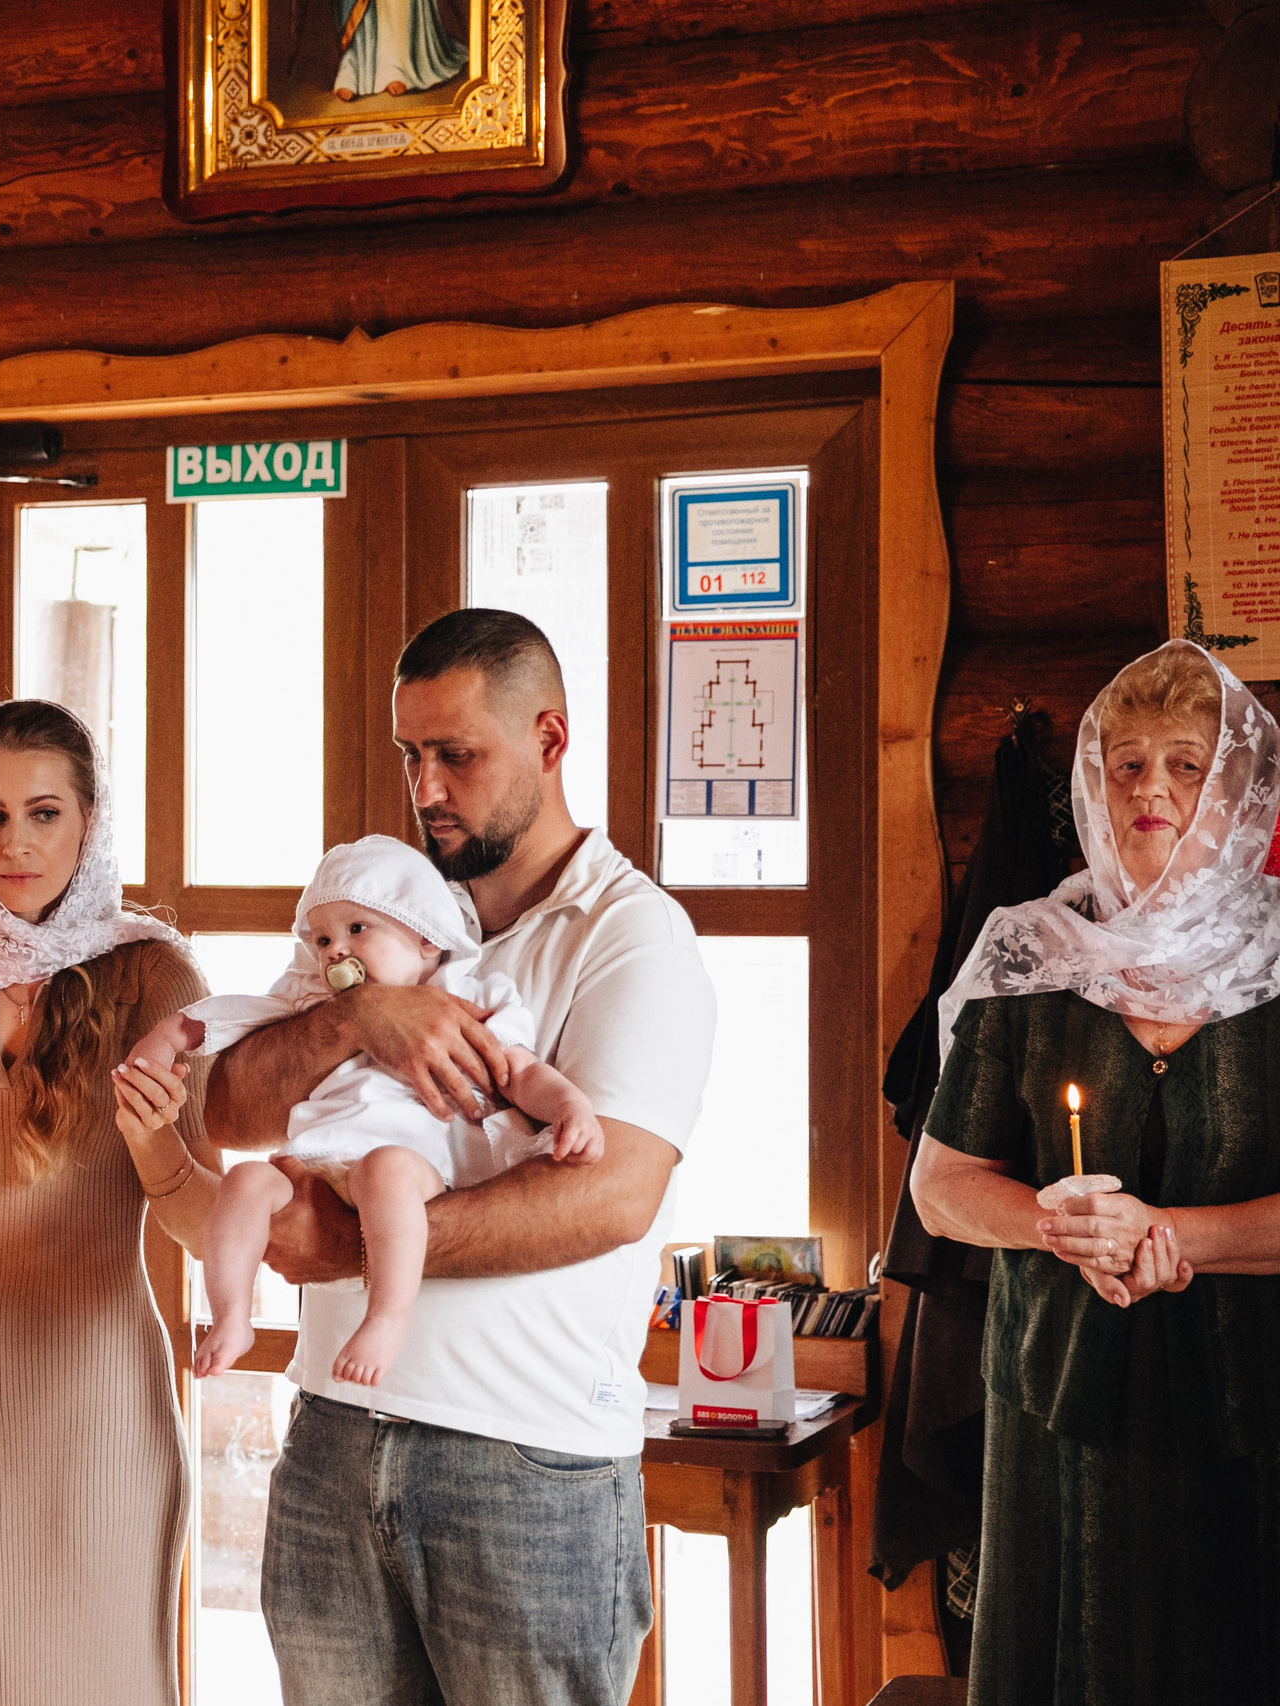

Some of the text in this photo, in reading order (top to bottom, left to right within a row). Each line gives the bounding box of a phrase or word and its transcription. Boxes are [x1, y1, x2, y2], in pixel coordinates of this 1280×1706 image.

[1219, 320, 1271, 335] Десять
[177, 441, 335, 488] ВЫХОД
[697, 505, 760, 517] Ответственный
[712, 527, 754, 536] состояние
[700, 574, 722, 593] 01
[741, 571, 766, 585] 112
[676, 624, 714, 636] ПЛАН
[717, 1412, 753, 1421] ЗОЛОТОЙ
